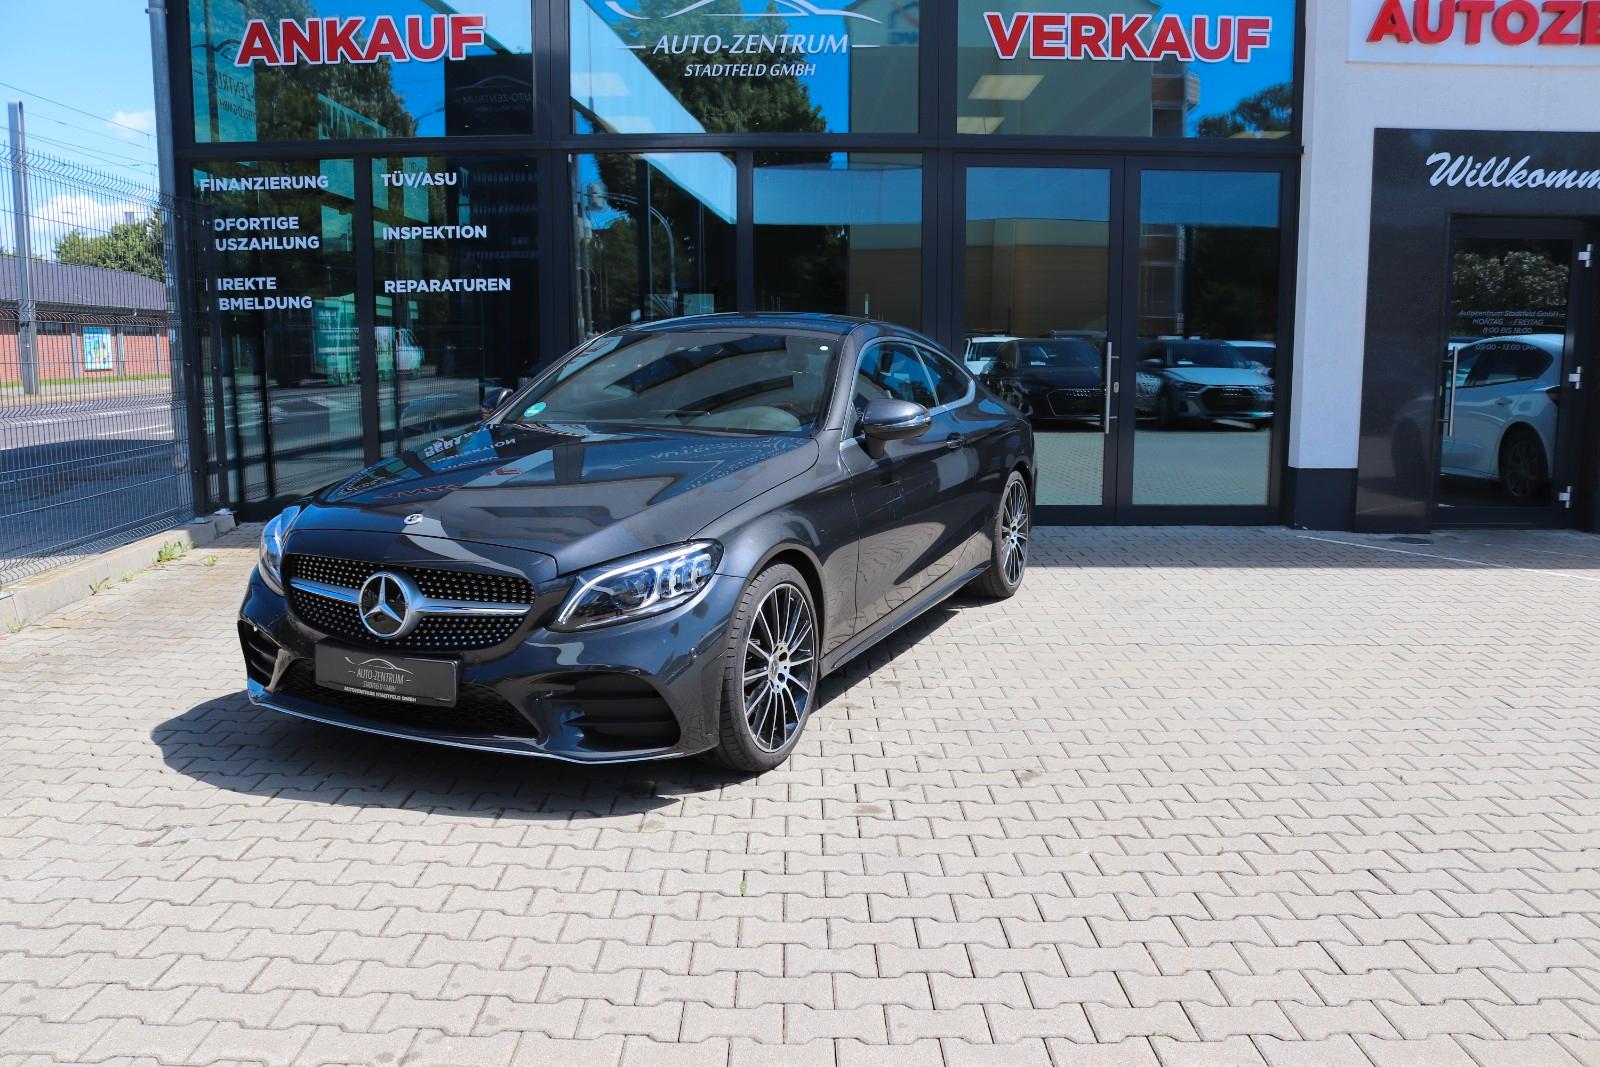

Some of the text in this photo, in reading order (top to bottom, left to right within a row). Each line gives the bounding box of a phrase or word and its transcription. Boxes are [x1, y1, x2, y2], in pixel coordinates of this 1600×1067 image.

[234, 14, 486, 67] ANKAUF
[653, 34, 848, 55] AUTO-ZENTRUM
[984, 10, 1274, 63] VERKAUF
[684, 63, 817, 77] STADTFELD GMBH
[200, 175, 329, 192] FINANZIERUNG
[381, 171, 457, 189] TÜV/ASU
[203, 216, 299, 232] OFORTIGE
[382, 225, 487, 241] INSPEKTION
[204, 236, 320, 252] USZAHLUNG
[206, 277, 277, 291] IREKTE
[384, 278, 511, 294] REPARATUREN
[207, 296, 313, 311] BMELDUNG
[356, 668, 405, 684] AUTO-ZENTRUM
